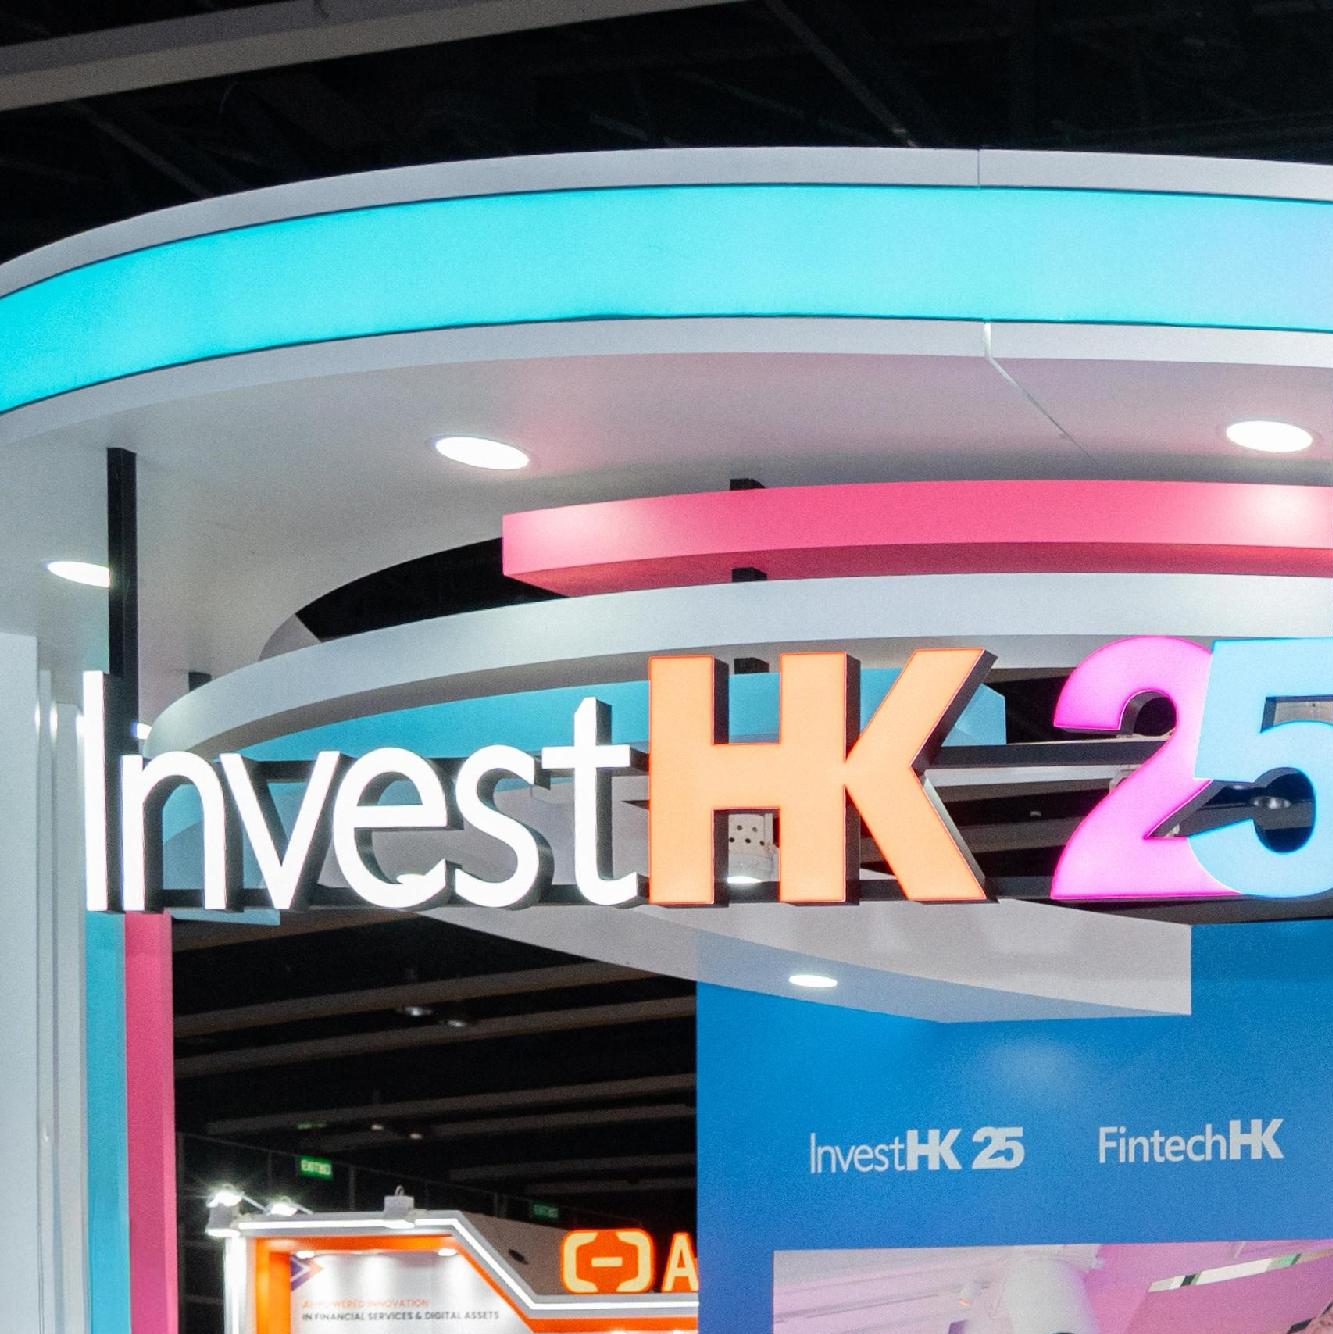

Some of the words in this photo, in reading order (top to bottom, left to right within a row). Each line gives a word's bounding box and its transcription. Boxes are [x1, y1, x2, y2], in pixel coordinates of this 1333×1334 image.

[84, 648, 995, 912] InvestHK
[811, 1129, 962, 1173] InvestHK
[972, 1127, 1024, 1170] 25
[1099, 1119, 1284, 1164] FintechHK
